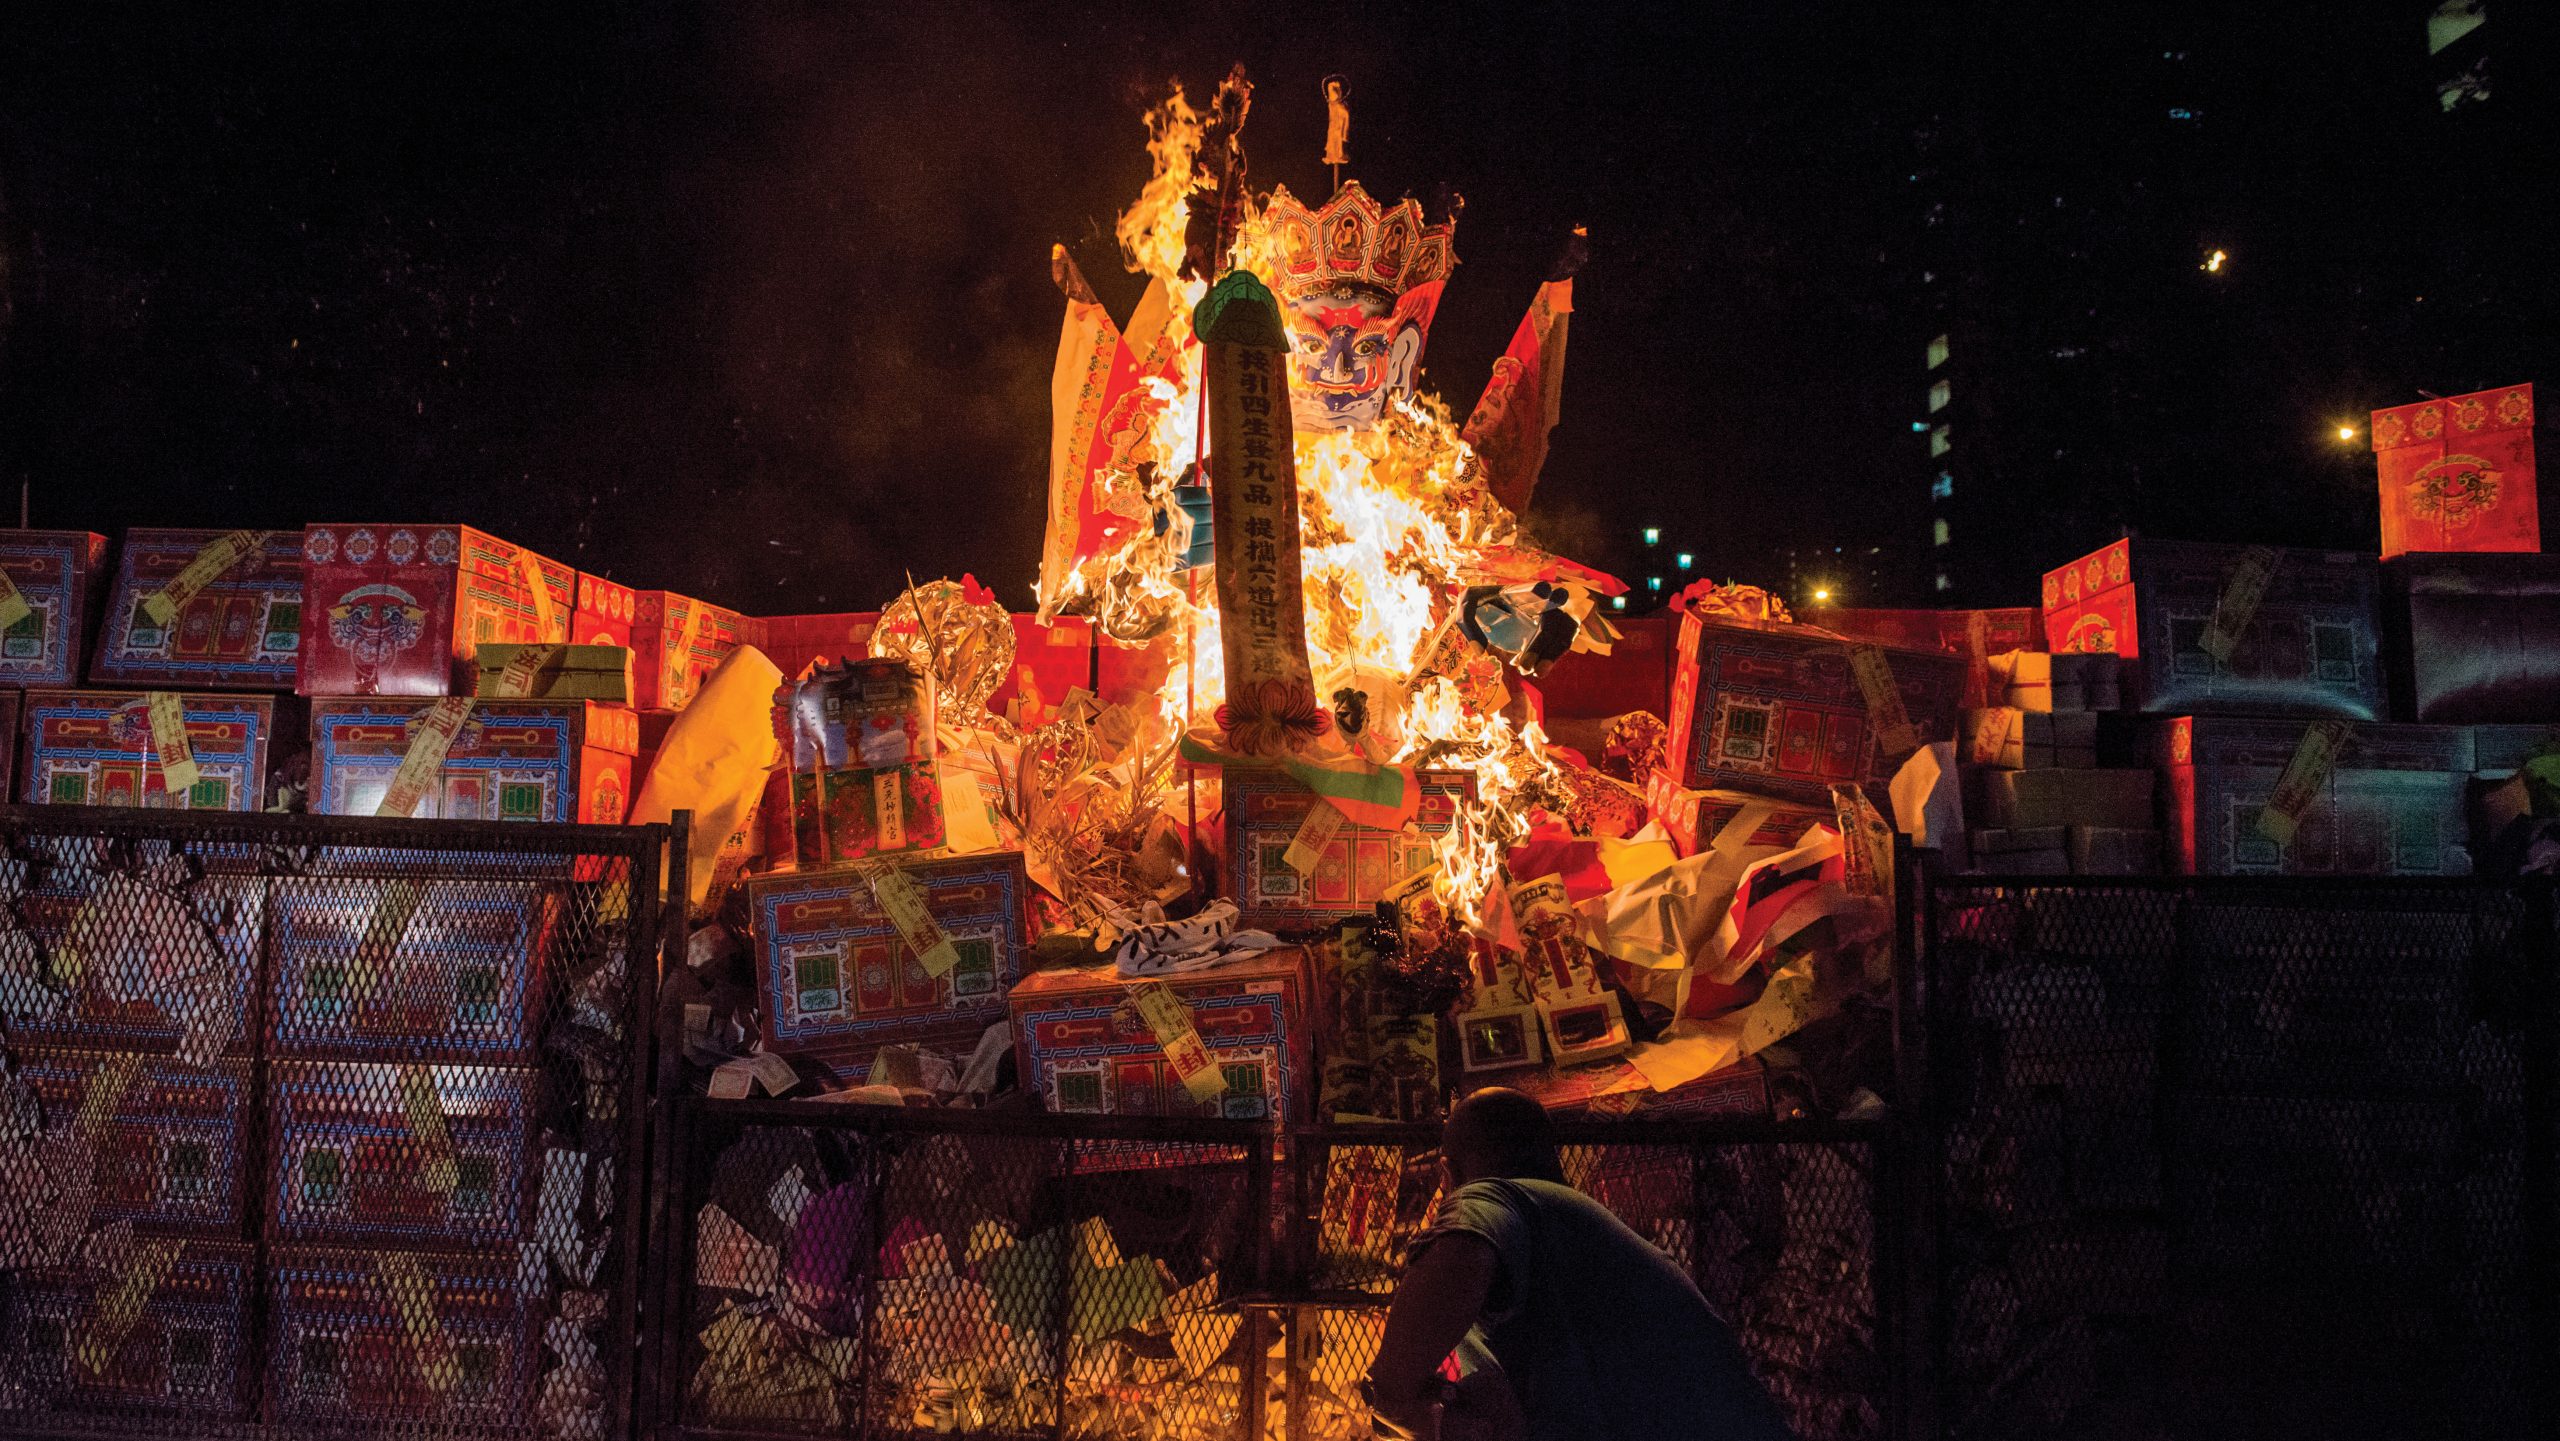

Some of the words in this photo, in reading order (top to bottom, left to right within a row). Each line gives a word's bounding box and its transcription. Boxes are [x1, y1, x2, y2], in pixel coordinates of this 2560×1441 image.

[162, 739, 187, 766] 封
[912, 924, 941, 952] 封
[1177, 1045, 1208, 1077] 封
